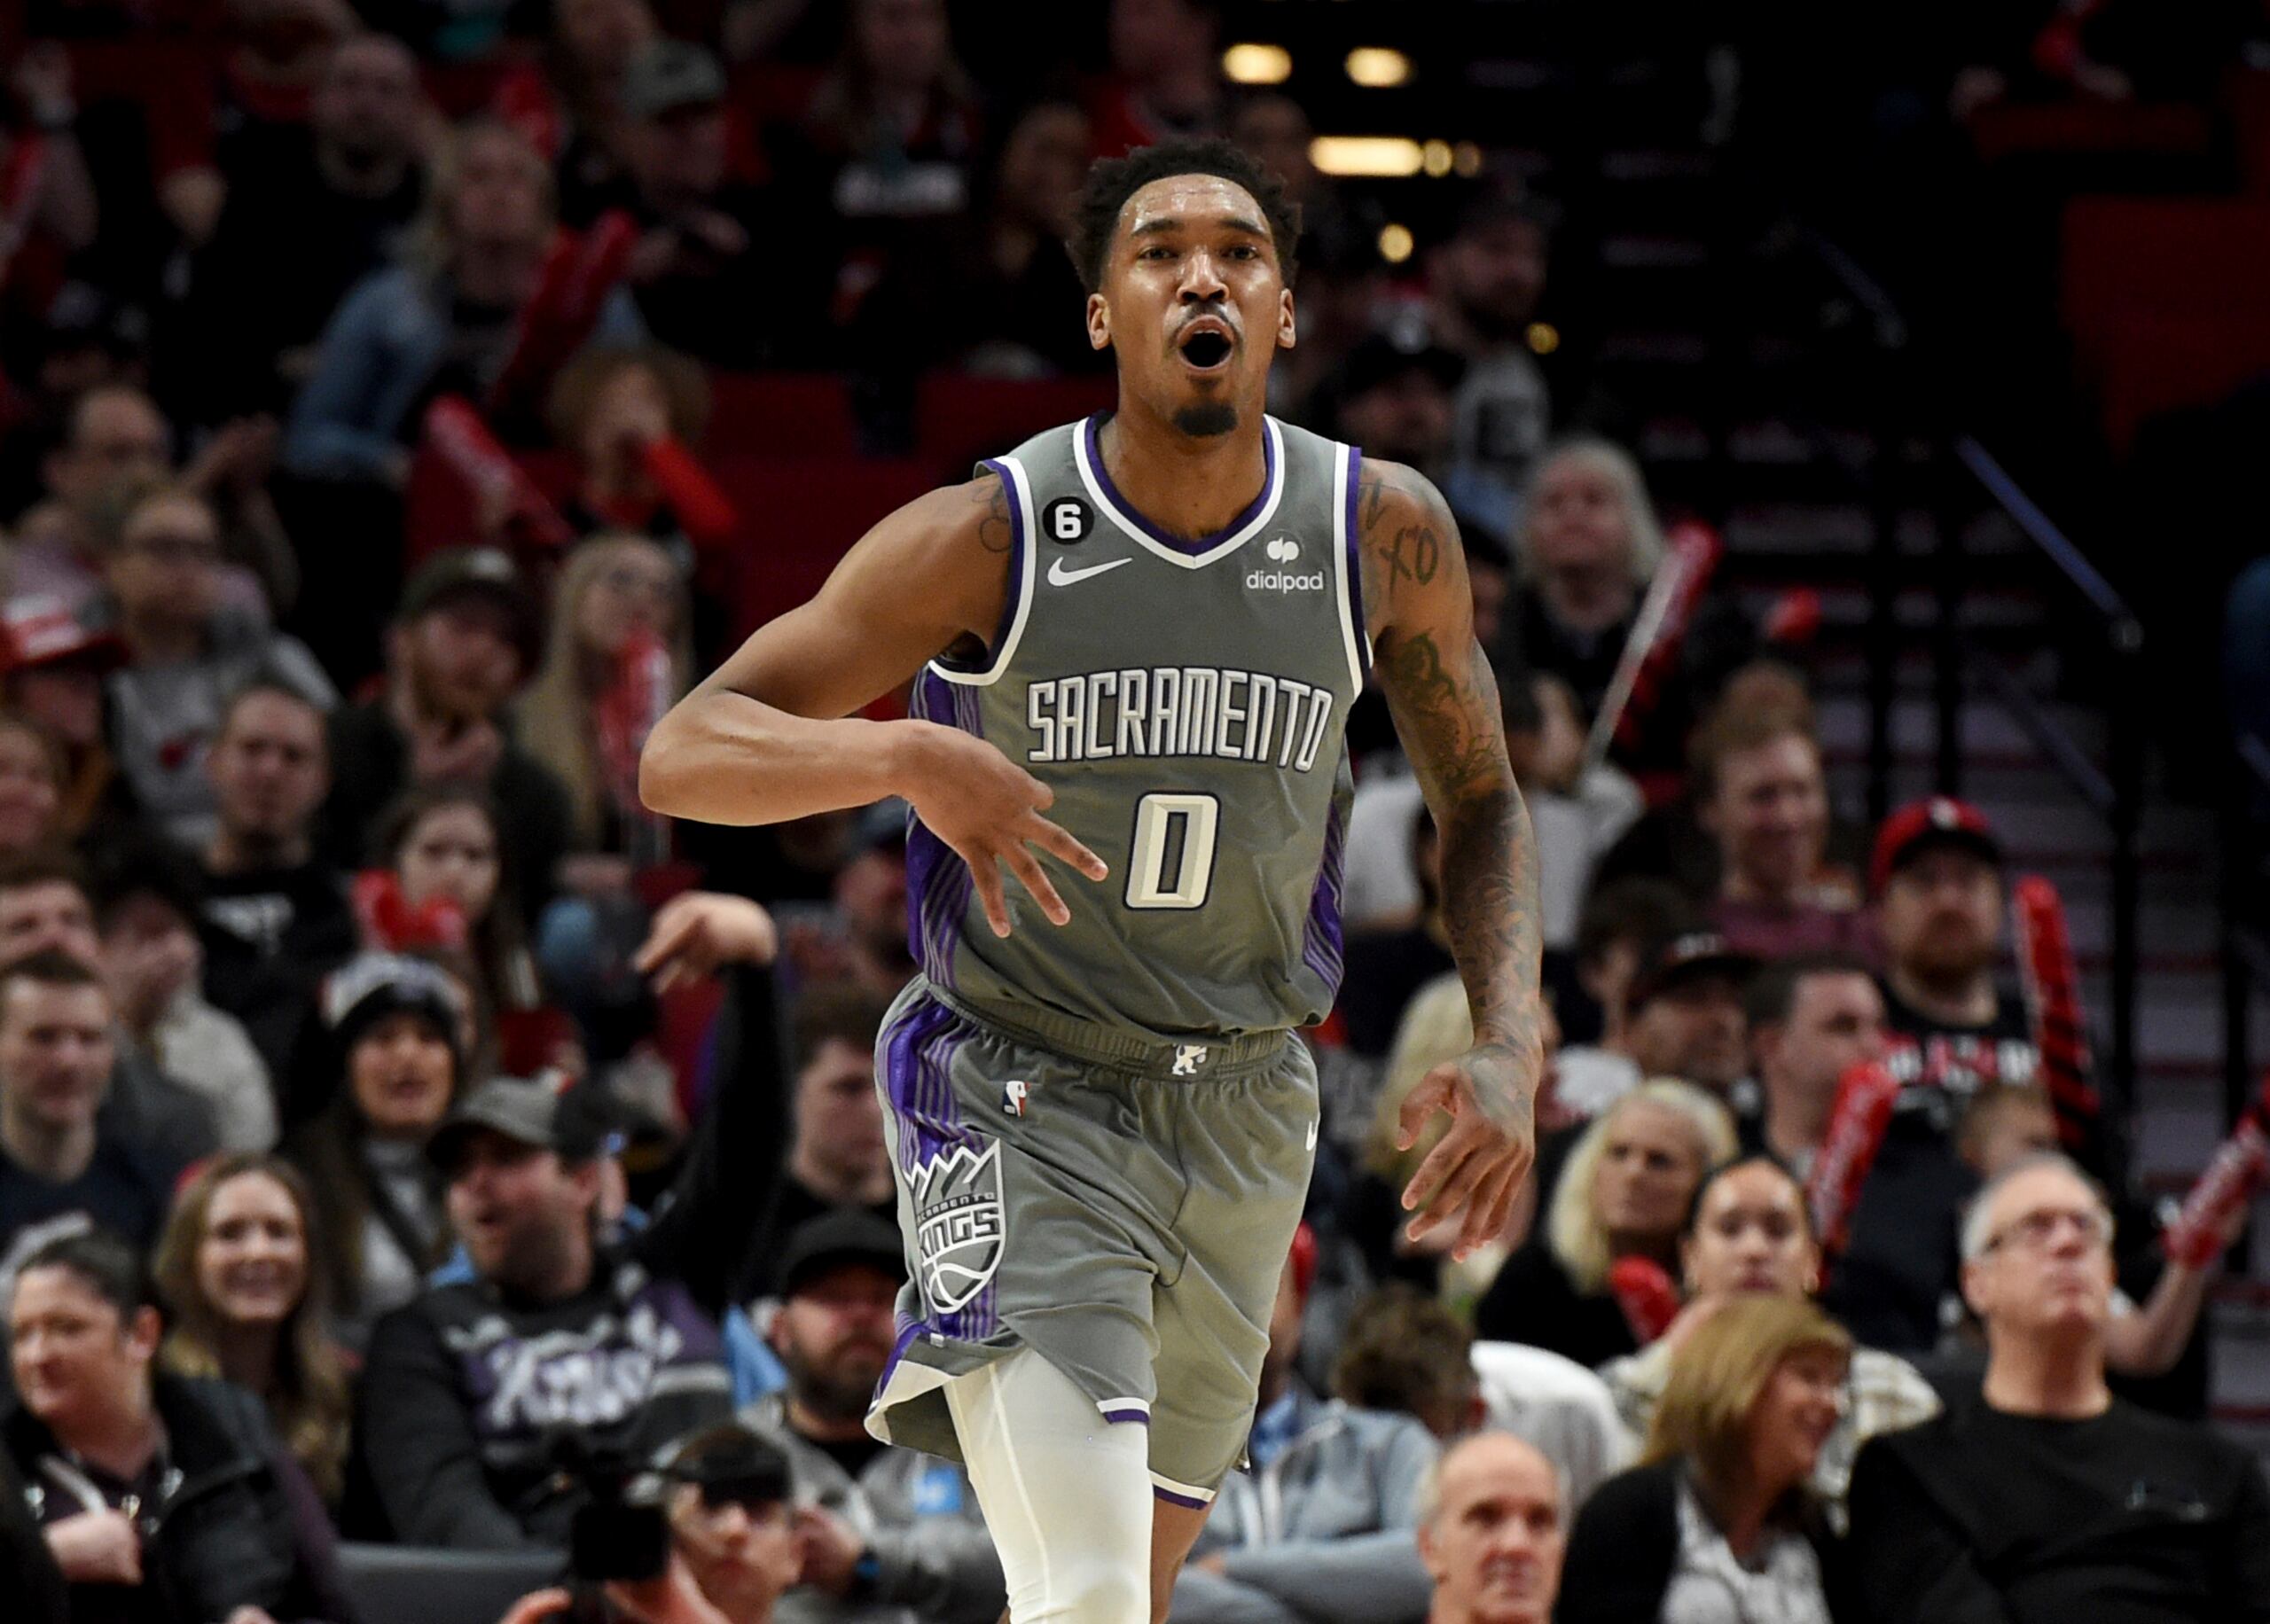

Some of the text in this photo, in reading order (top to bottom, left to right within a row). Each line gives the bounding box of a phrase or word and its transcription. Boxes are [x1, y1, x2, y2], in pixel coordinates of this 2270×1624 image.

[1055, 504, 1082, 539] 6
[1246, 570, 1324, 595] dialpad
[1027, 667, 1334, 773] SACRAMENTO
[1124, 791, 1221, 910] 0
[917, 1191, 996, 1223] CRAMENTO
